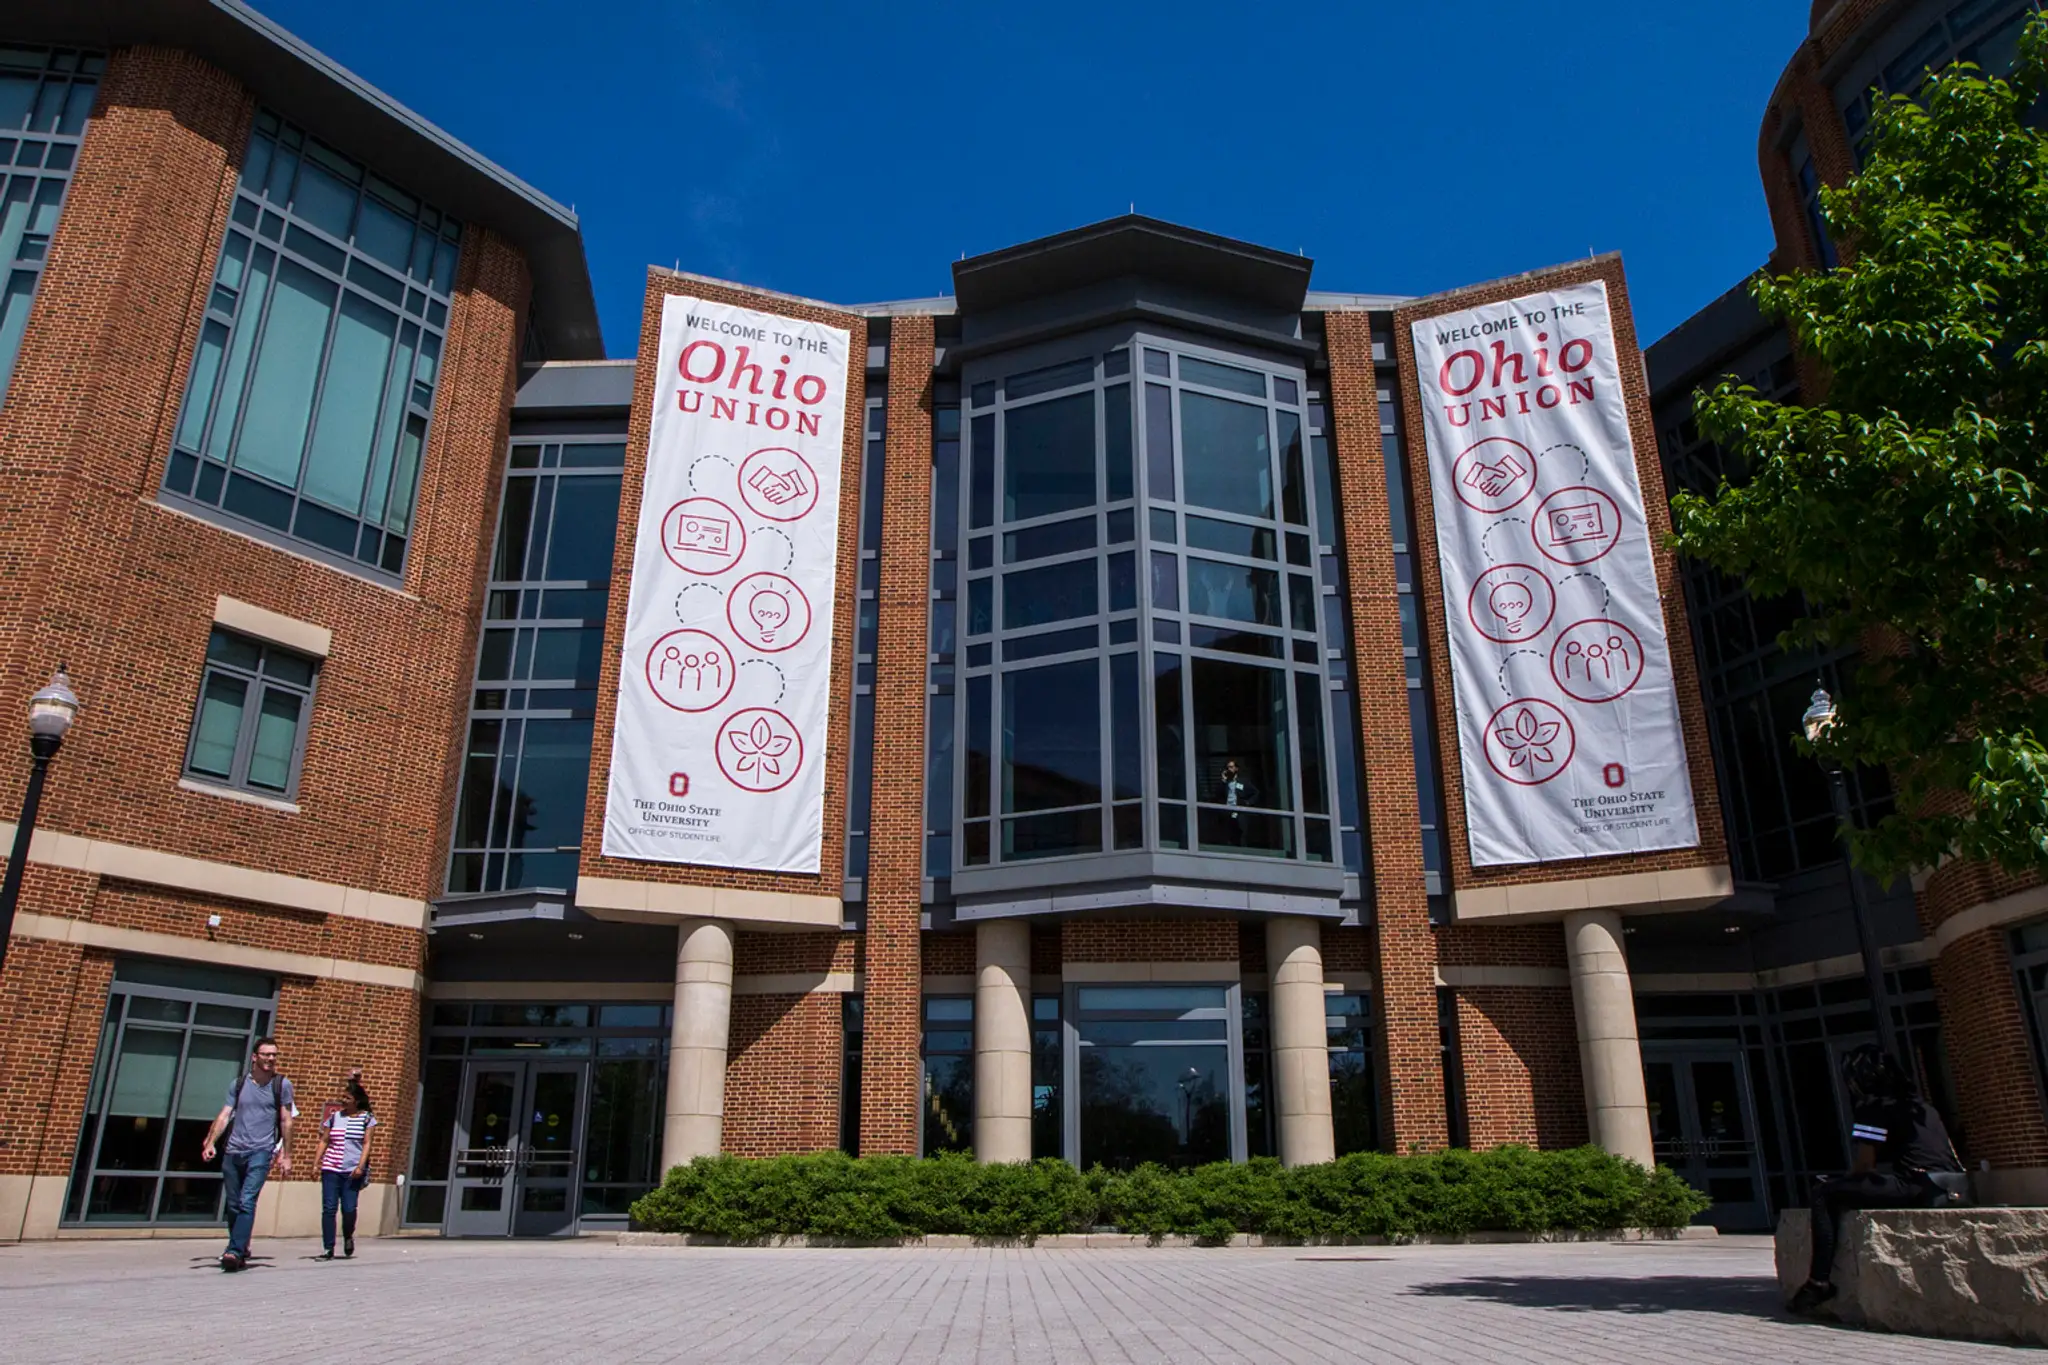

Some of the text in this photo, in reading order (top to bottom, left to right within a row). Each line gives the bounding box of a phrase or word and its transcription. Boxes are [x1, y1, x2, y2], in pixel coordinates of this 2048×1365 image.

[686, 314, 828, 354] WELCOME TO THE
[1435, 302, 1585, 345] WELCOME TO THE
[678, 340, 827, 405] Ohio
[1439, 332, 1593, 397] Ohio
[677, 389, 822, 437] UNION
[1444, 376, 1595, 427] UNION
[689, 804, 722, 817] STATE
[1584, 804, 1654, 818] UNIVERSITY
[1630, 790, 1666, 801] STATE
[642, 811, 711, 827] UNIVERSITY
